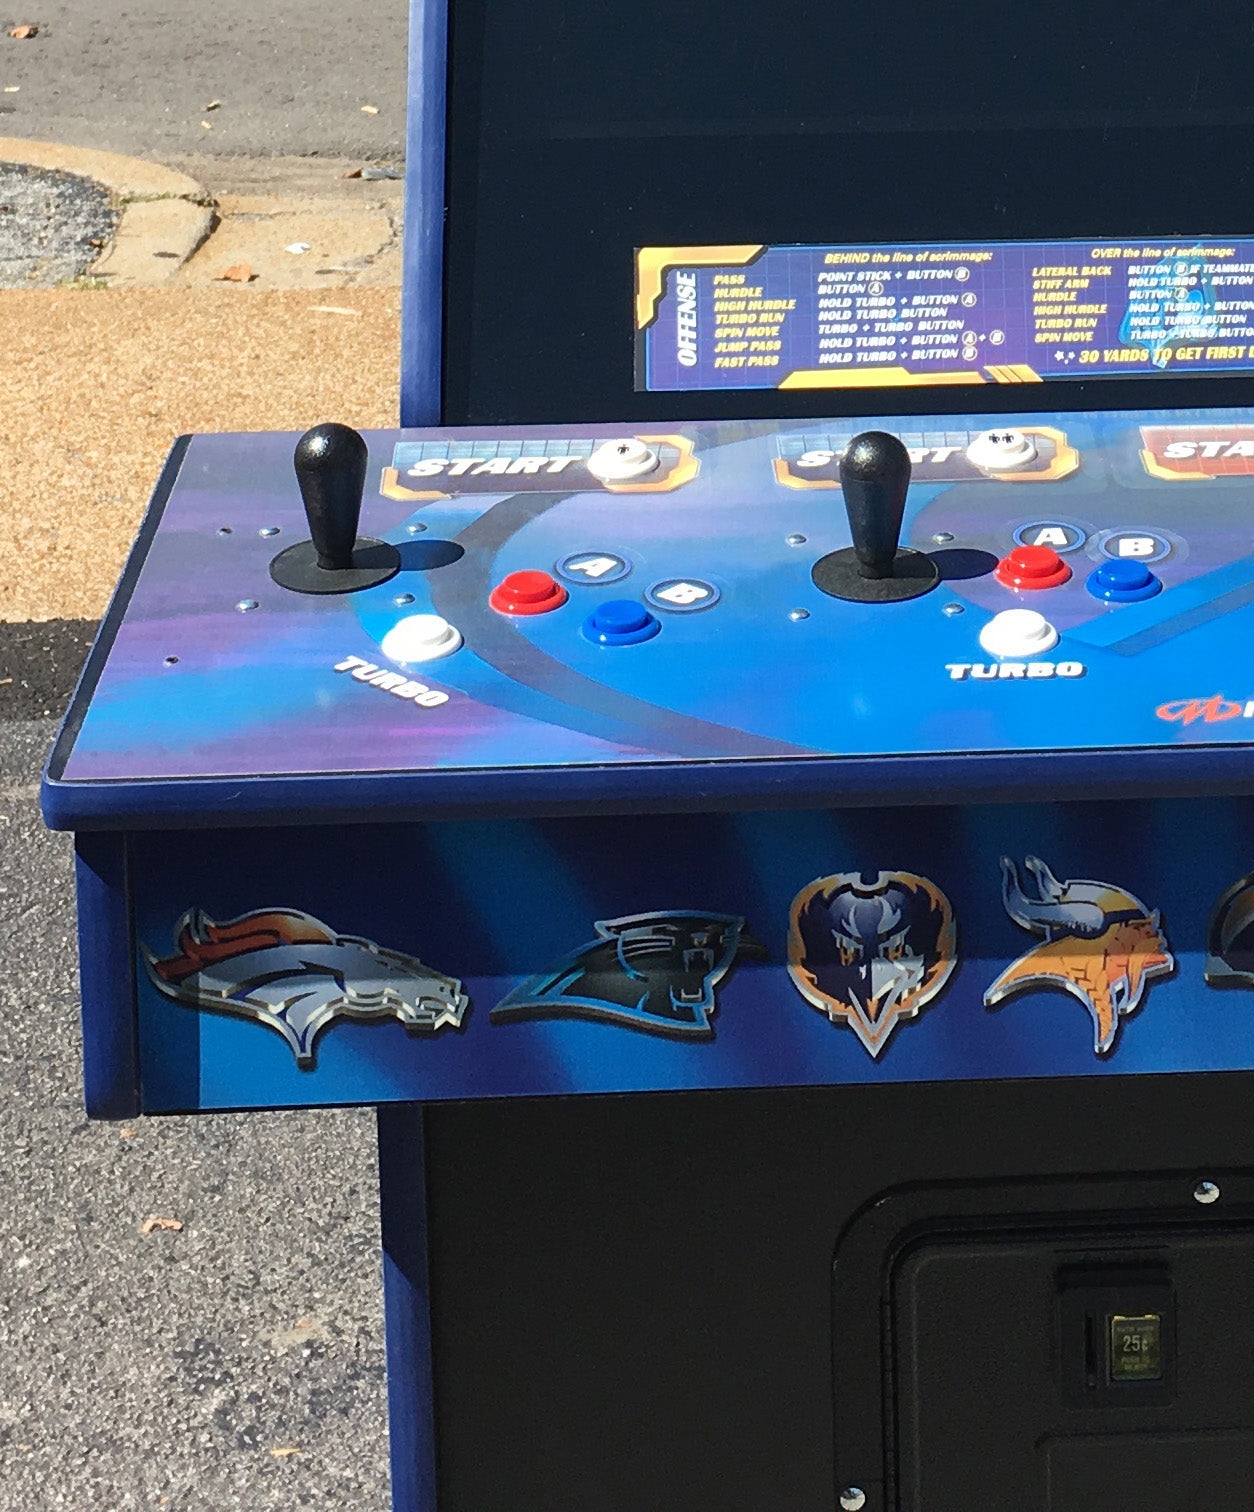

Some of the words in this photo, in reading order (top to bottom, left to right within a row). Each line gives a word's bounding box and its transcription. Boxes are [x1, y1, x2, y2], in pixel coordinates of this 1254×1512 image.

[825, 253, 869, 264] BEHIND
[872, 253, 890, 262] the
[892, 252, 912, 262] line
[916, 252, 927, 261] of
[929, 252, 993, 262] scrimmage:
[1091, 248, 1121, 258] OVER
[1123, 248, 1139, 258] the
[1142, 248, 1161, 257] line
[1164, 247, 1176, 256] of
[1177, 248, 1235, 257] scrimmage:
[818, 272, 855, 282] POINT
[857, 271, 892, 281] STICK
[907, 270, 953, 280] BUTTON
[1032, 267, 1079, 276] LATERAL
[1082, 266, 1112, 276] BACK
[1128, 265, 1171, 275] BUTTON
[714, 275, 745, 285] PASS
[1128, 278, 1157, 287] HOLD
[1159, 277, 1197, 286] TURBO
[1212, 276, 1253, 285] BUTTON
[818, 284, 866, 294] BUTTON
[1129, 290, 1172, 299] BUTTON
[818, 298, 852, 308] HOLD
[856, 296, 895, 307] TURBO
[912, 295, 959, 305] BUTTON
[1129, 303, 1159, 312] HOLD
[1164, 302, 1199, 311] TURBO
[677, 271, 697, 366] OFFENSE
[716, 314, 757, 324] TURBO
[759, 313, 785, 323] RUN
[819, 310, 852, 321] HOLD
[856, 309, 897, 320] TURBO
[901, 308, 948, 318] BUTTON
[1130, 316, 1160, 326] HOLD
[1203, 315, 1247, 324] BUTTON
[819, 324, 858, 334] TURBO
[875, 322, 913, 332] TURBO
[918, 320, 964, 330] BUTTON
[1035, 319, 1072, 329] TURBO
[715, 328, 744, 338] SPIN
[745, 326, 780, 337] MOVE
[1063, 332, 1094, 342] MOVE
[1131, 330, 1167, 340] TURBO
[750, 340, 781, 351] PASS
[819, 338, 852, 349] HOLD
[856, 337, 896, 347] TURBO
[912, 335, 958, 345] BUTTON
[819, 353, 852, 363] HOLD
[857, 351, 896, 362] TURBO
[912, 349, 958, 360] BUTTON
[1079, 350, 1099, 363] 30
[1104, 349, 1149, 362] YARDS
[1155, 348, 1172, 360] TO
[1176, 348, 1201, 360] GET
[1206, 346, 1246, 359] FIRST
[715, 357, 746, 367] FAST
[748, 356, 779, 366] PASS
[408, 456, 582, 478] START
[1033, 527, 1068, 546] A
[1119, 538, 1154, 556] B
[569, 558, 618, 577] A
[656, 583, 708, 604] B
[945, 662, 1085, 679] TURBO
[334, 655, 449, 707] TURBO
[1123, 1335, 1148, 1352] 25¢
